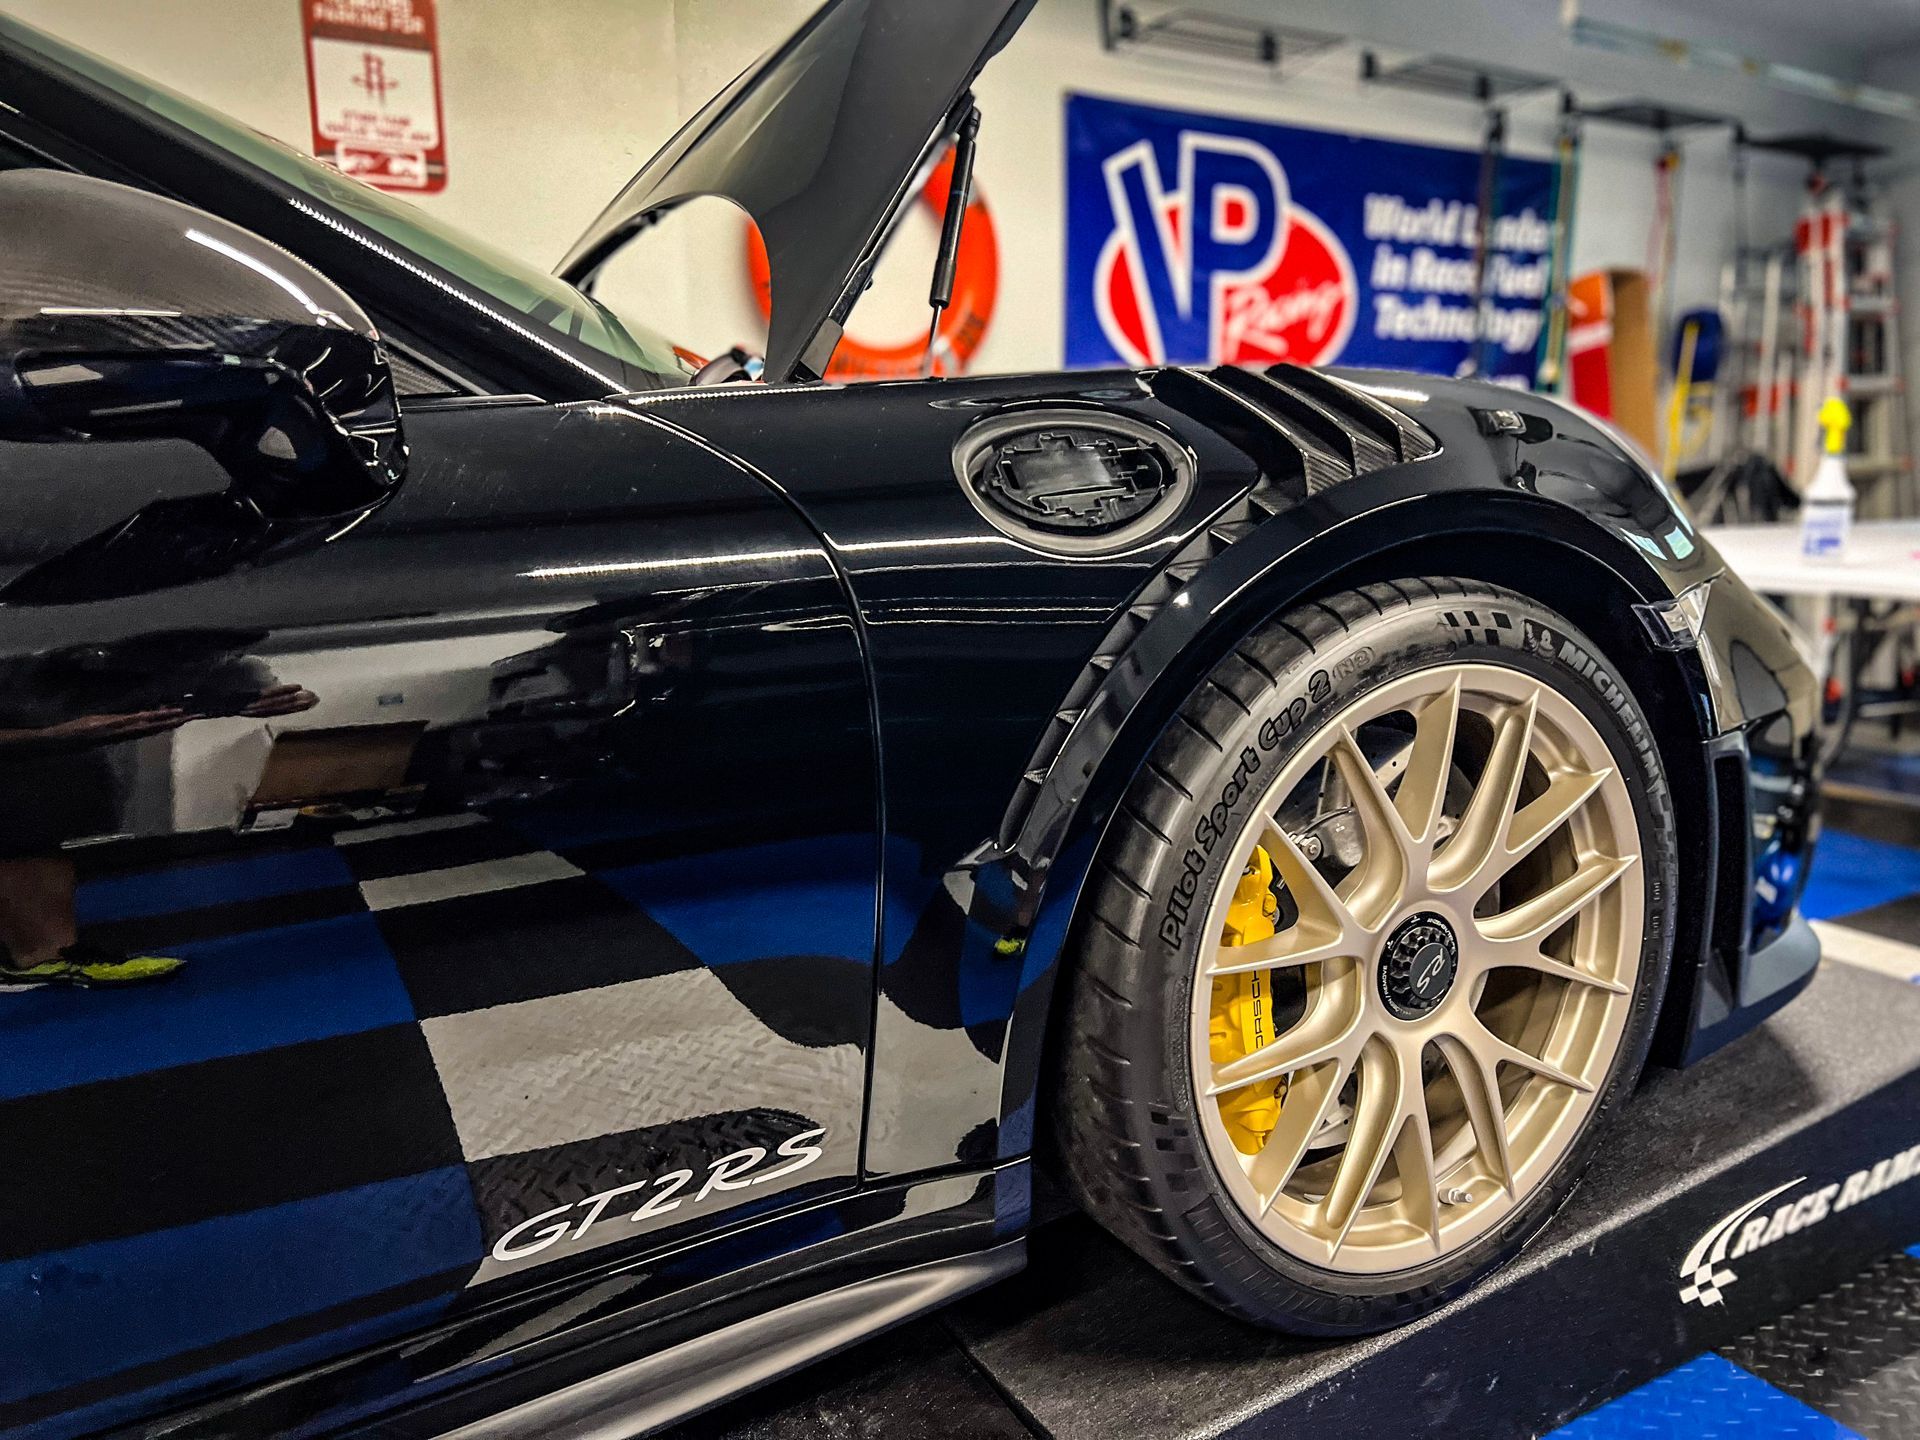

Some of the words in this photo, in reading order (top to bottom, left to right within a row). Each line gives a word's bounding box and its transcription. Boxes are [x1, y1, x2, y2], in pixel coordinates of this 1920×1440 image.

[1102, 130, 1292, 368] VP
[1363, 192, 1462, 247] World
[1463, 203, 1562, 252] Lade
[1371, 243, 1407, 291] in
[1374, 292, 1542, 354] Technology
[1558, 640, 1666, 795] MICHELIN
[1158, 848, 1206, 951] Pilot
[1194, 746, 1261, 856] Sport
[1258, 697, 1307, 751] Cup
[1309, 669, 1331, 703] 2
[1251, 969, 1264, 1049] ORSCH
[1416, 947, 1446, 994] RS
[1730, 1183, 1840, 1260] RACE
[1833, 1144, 1920, 1213] RAM
